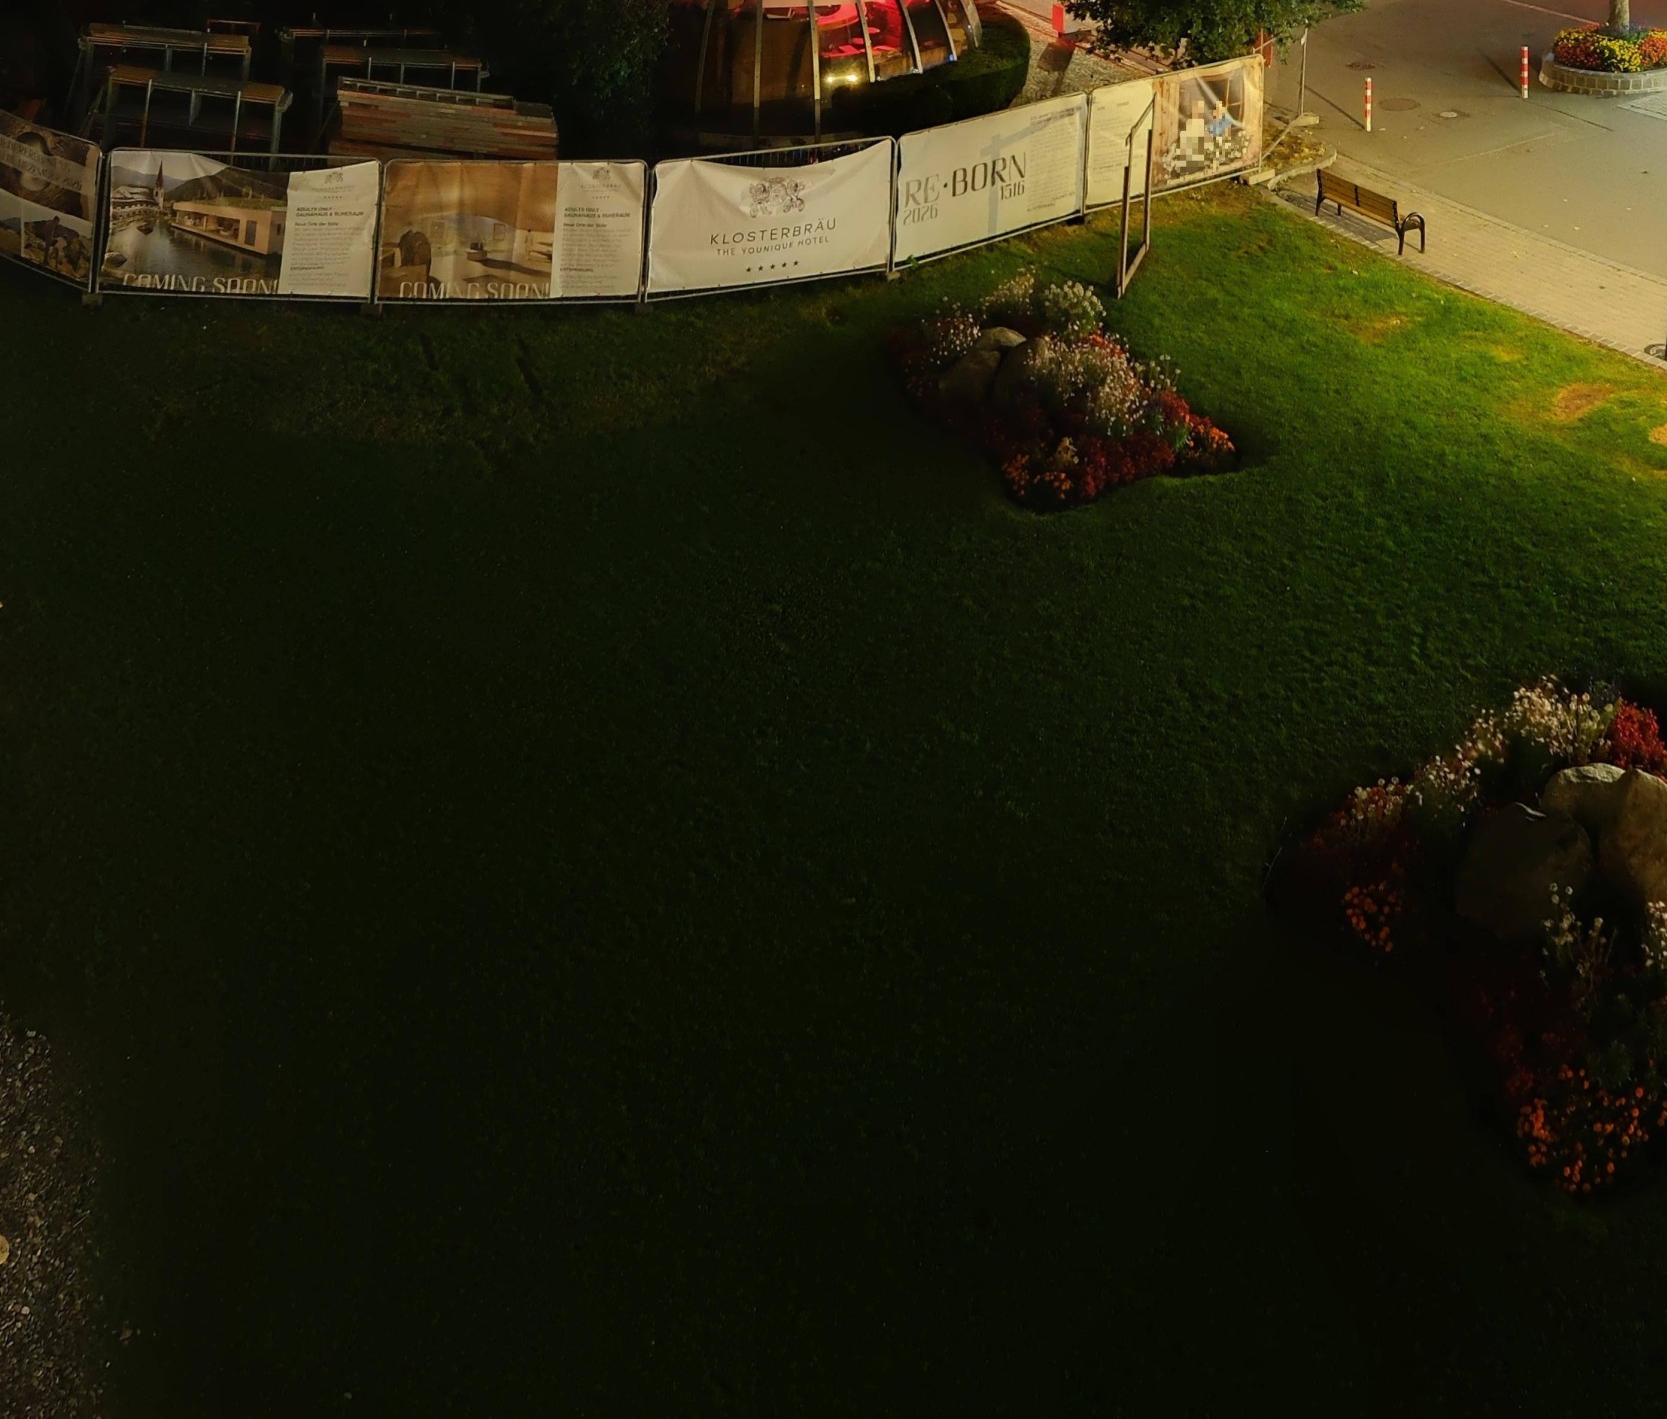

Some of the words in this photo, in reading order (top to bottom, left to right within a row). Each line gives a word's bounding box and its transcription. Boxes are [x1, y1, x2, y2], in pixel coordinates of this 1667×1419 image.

[1000, 181, 1025, 201] 1516
[903, 205, 938, 226] 2026
[710, 217, 837, 245] KLOSTERBRÄU
[716, 248, 736, 256] THE
[741, 241, 794, 256] YOUNIQUE
[798, 237, 829, 248] HOTEL
[123, 273, 206, 294] COMING
[400, 281, 481, 299] COMING
